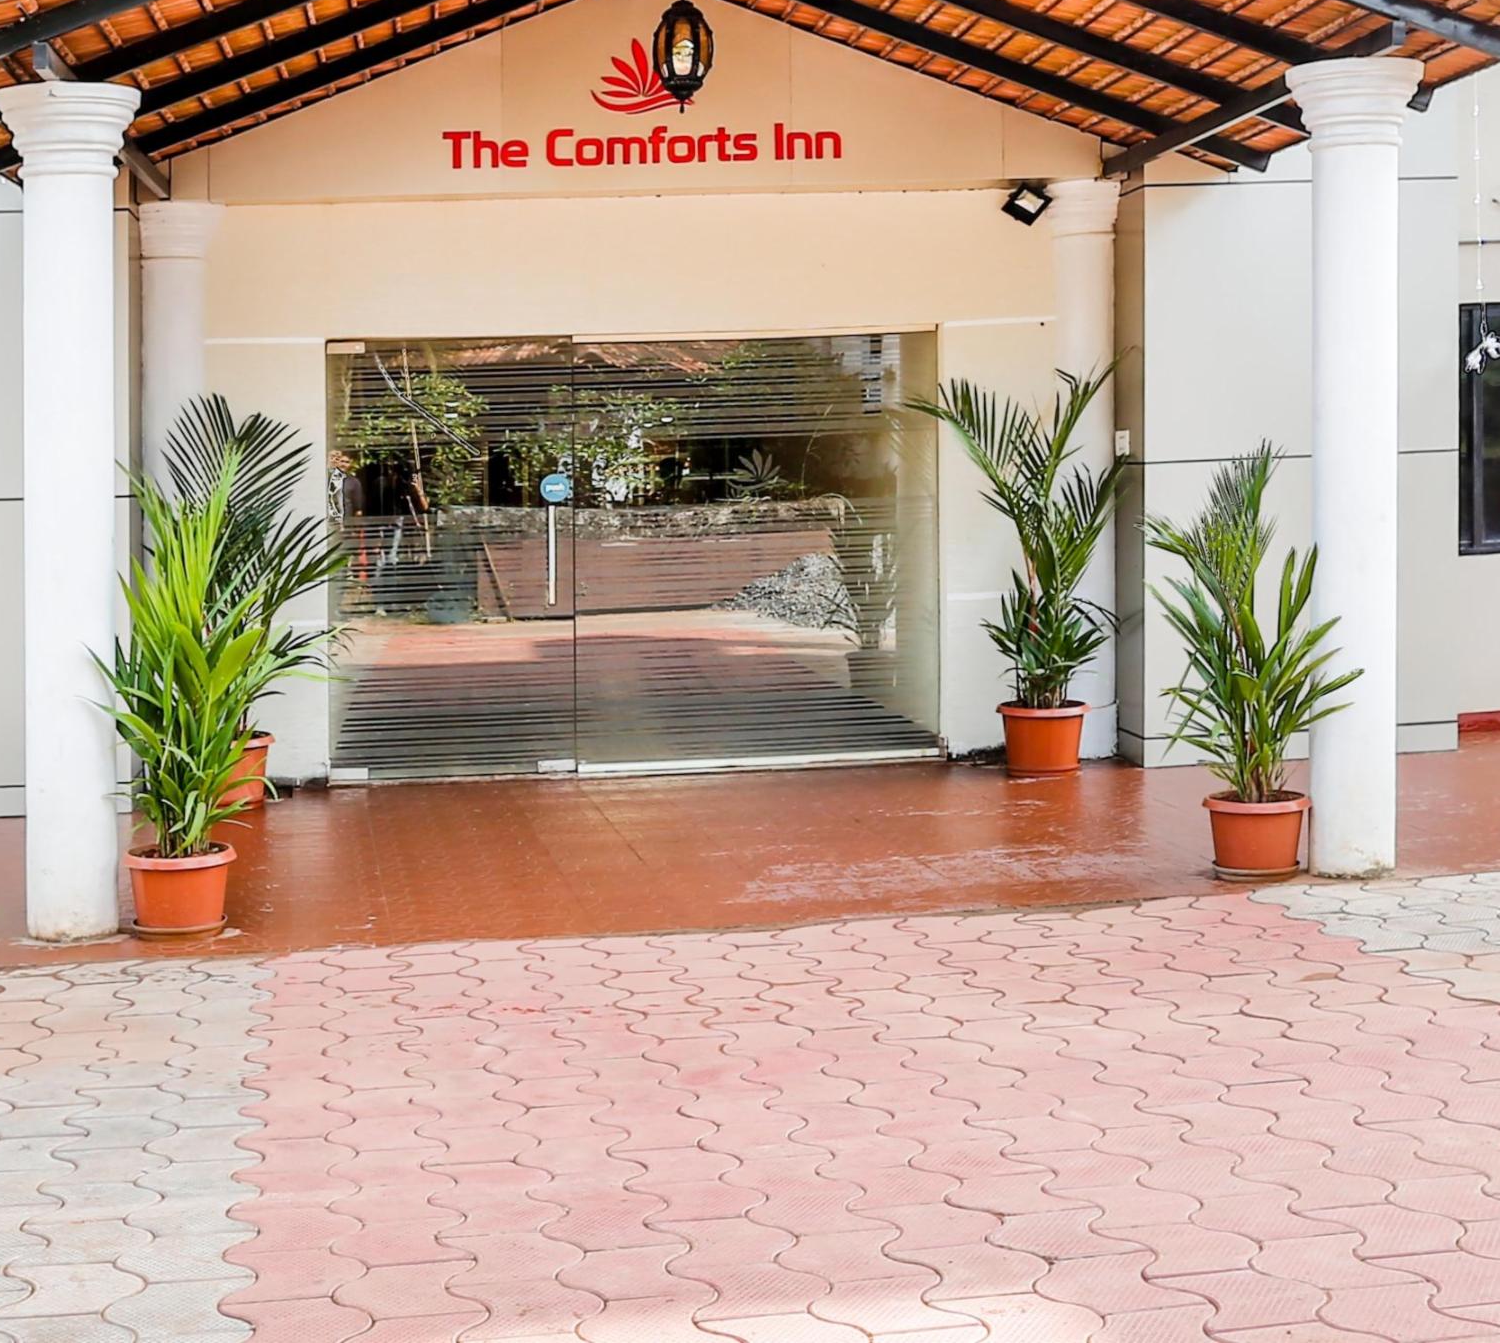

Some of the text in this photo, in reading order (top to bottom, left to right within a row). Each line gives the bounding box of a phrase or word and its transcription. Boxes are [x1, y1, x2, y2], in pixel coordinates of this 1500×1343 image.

[442, 123, 842, 169] The Comforts Inn
